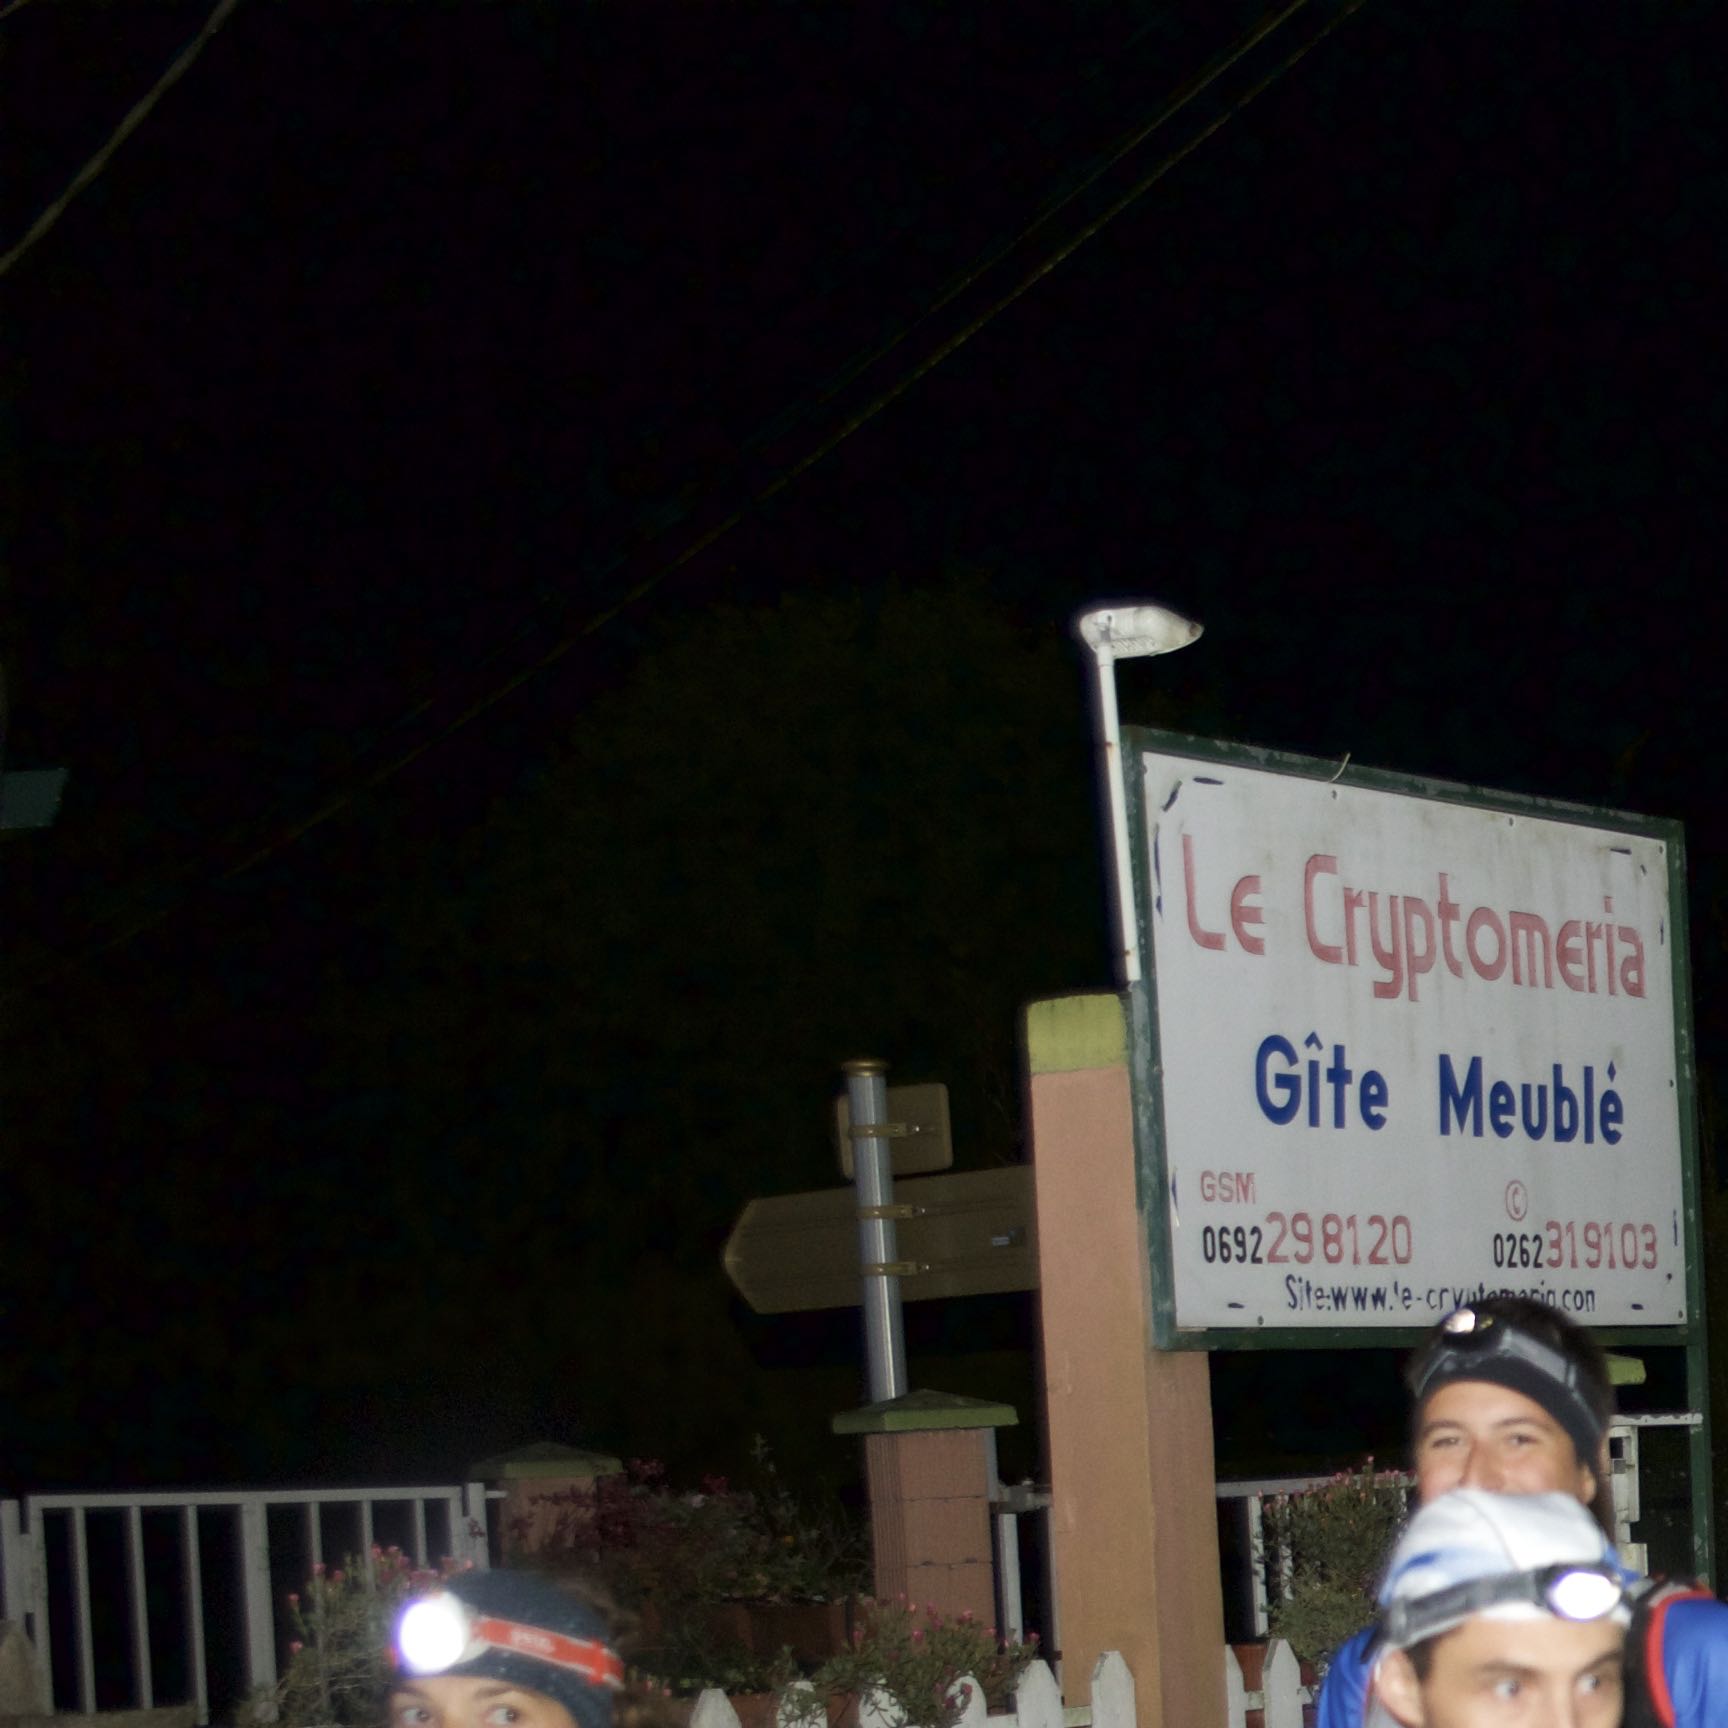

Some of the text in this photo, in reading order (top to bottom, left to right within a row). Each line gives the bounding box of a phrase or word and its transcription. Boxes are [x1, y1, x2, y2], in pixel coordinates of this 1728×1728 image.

[1305, 854, 1647, 1002] Cryptomeria
[1255, 1031, 1624, 1145] Gîte Meublé
[1201, 1170, 1256, 1204] GSM
